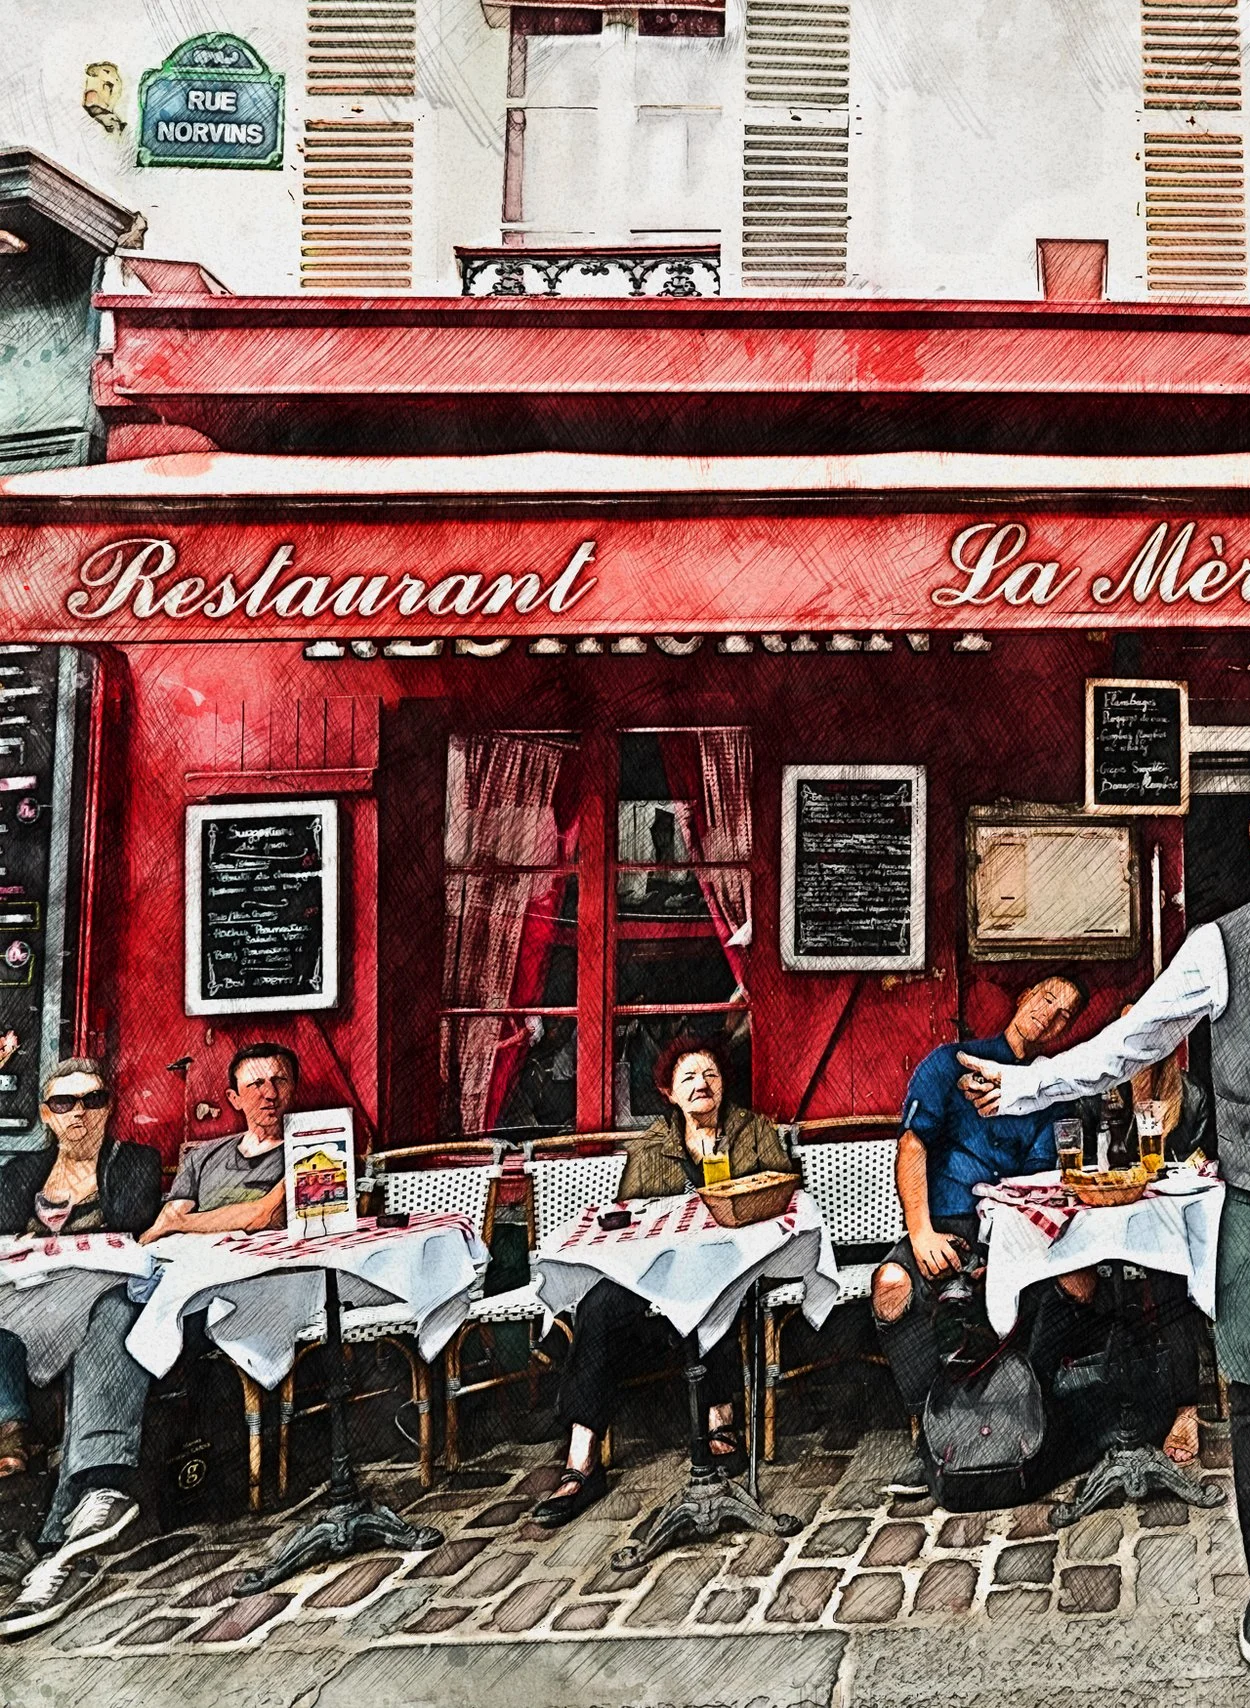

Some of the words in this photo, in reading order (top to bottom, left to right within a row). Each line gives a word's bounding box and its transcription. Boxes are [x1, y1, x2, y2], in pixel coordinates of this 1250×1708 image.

[188, 90, 237, 112] RUE
[157, 121, 263, 144] NORVINS
[67, 538, 597, 620] Restaurant
[931, 522, 1081, 606] La
